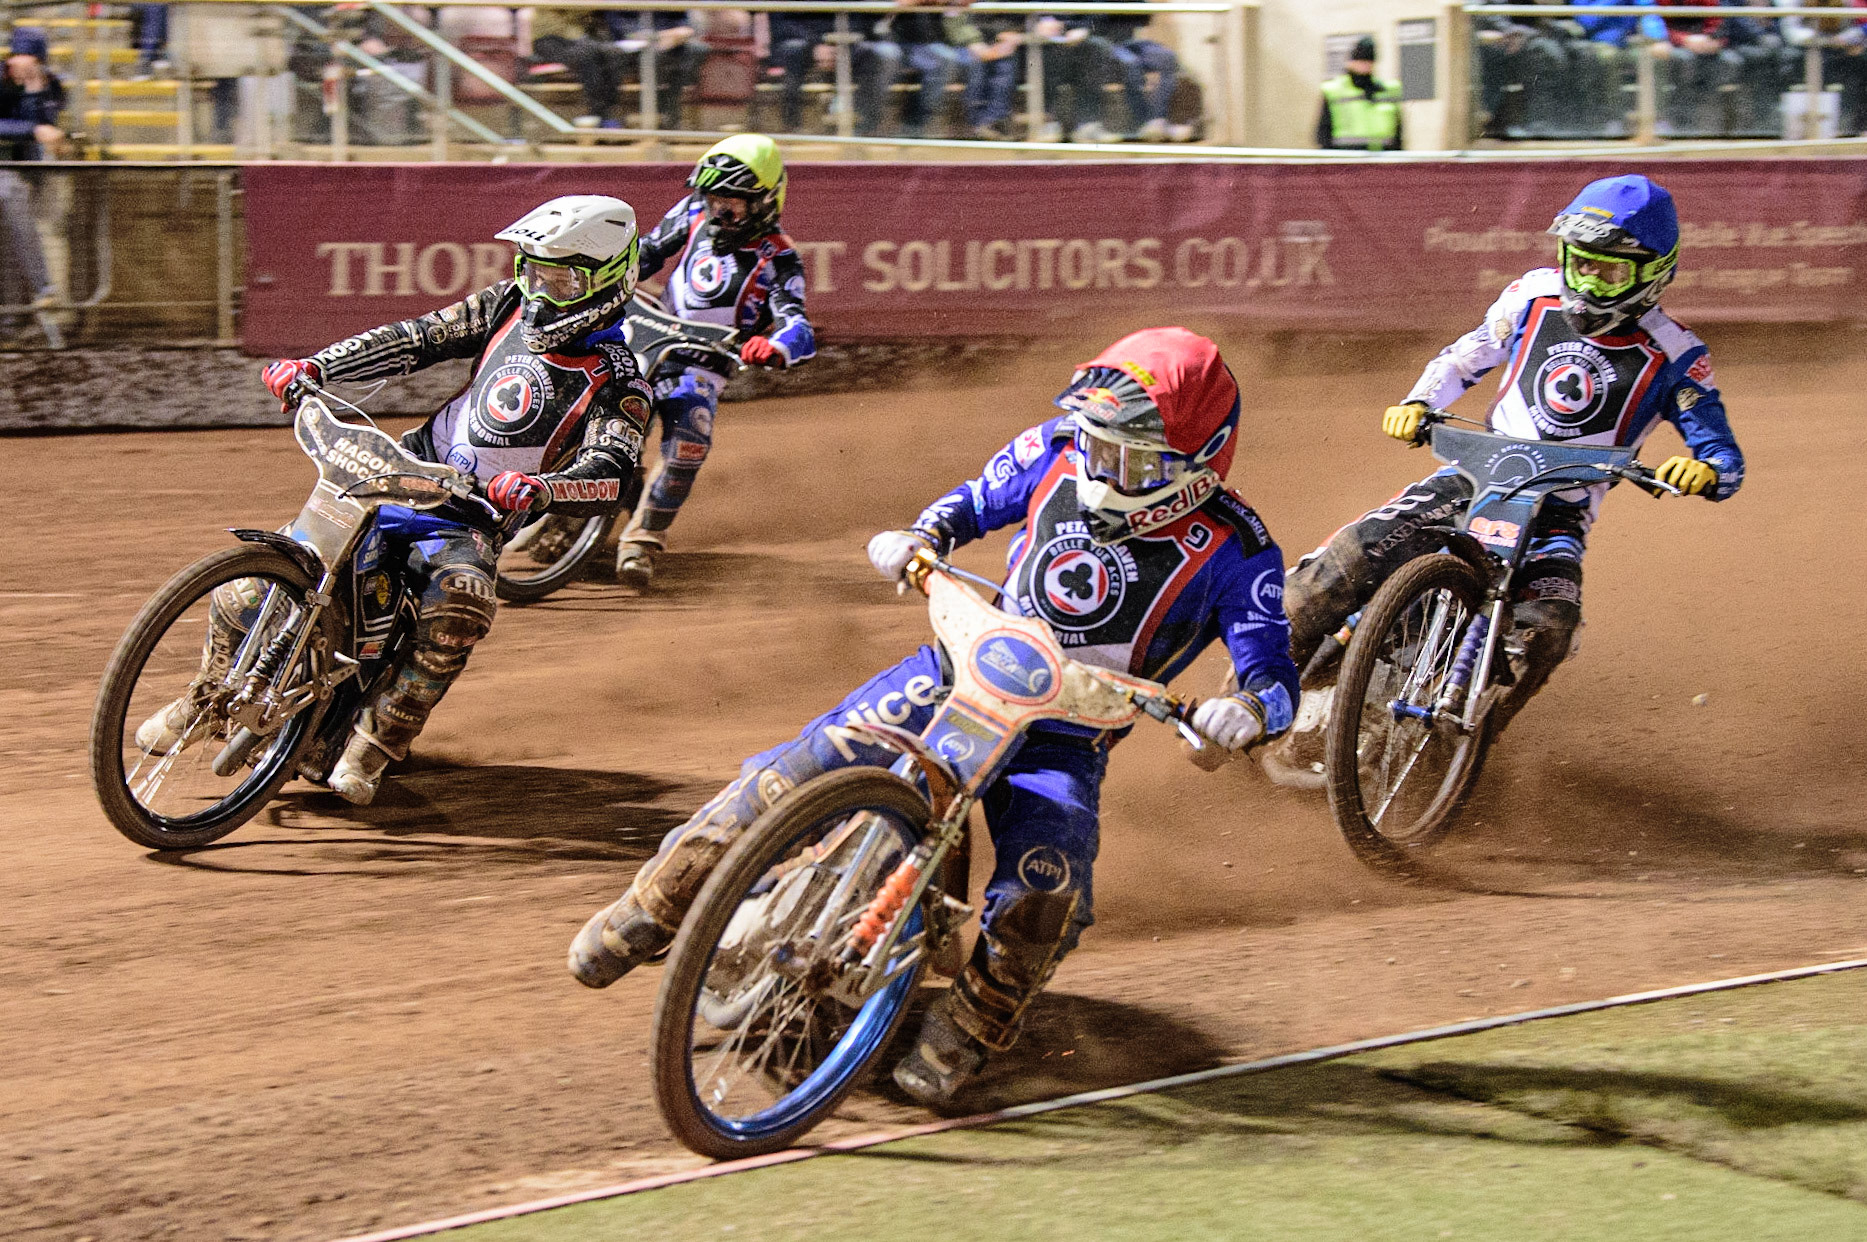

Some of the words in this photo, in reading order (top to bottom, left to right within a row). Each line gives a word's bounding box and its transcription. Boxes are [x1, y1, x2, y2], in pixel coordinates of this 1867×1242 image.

[504, 354, 533, 365] PETER
[531, 358, 556, 400] CRAVEN
[531, 386, 540, 409] ACES
[469, 407, 511, 446] MEMORIAL
[325, 449, 390, 493] SHOCKS
[333, 437, 399, 478] HAGON
[450, 451, 472, 470] ATPI
[551, 478, 621, 502] MOLDOW
[1126, 490, 1189, 533] Red
[1183, 521, 1213, 552] 9
[1048, 539, 1085, 556] BELLE
[1107, 566, 1120, 596] ACES
[1025, 859, 1063, 880] ATPI
